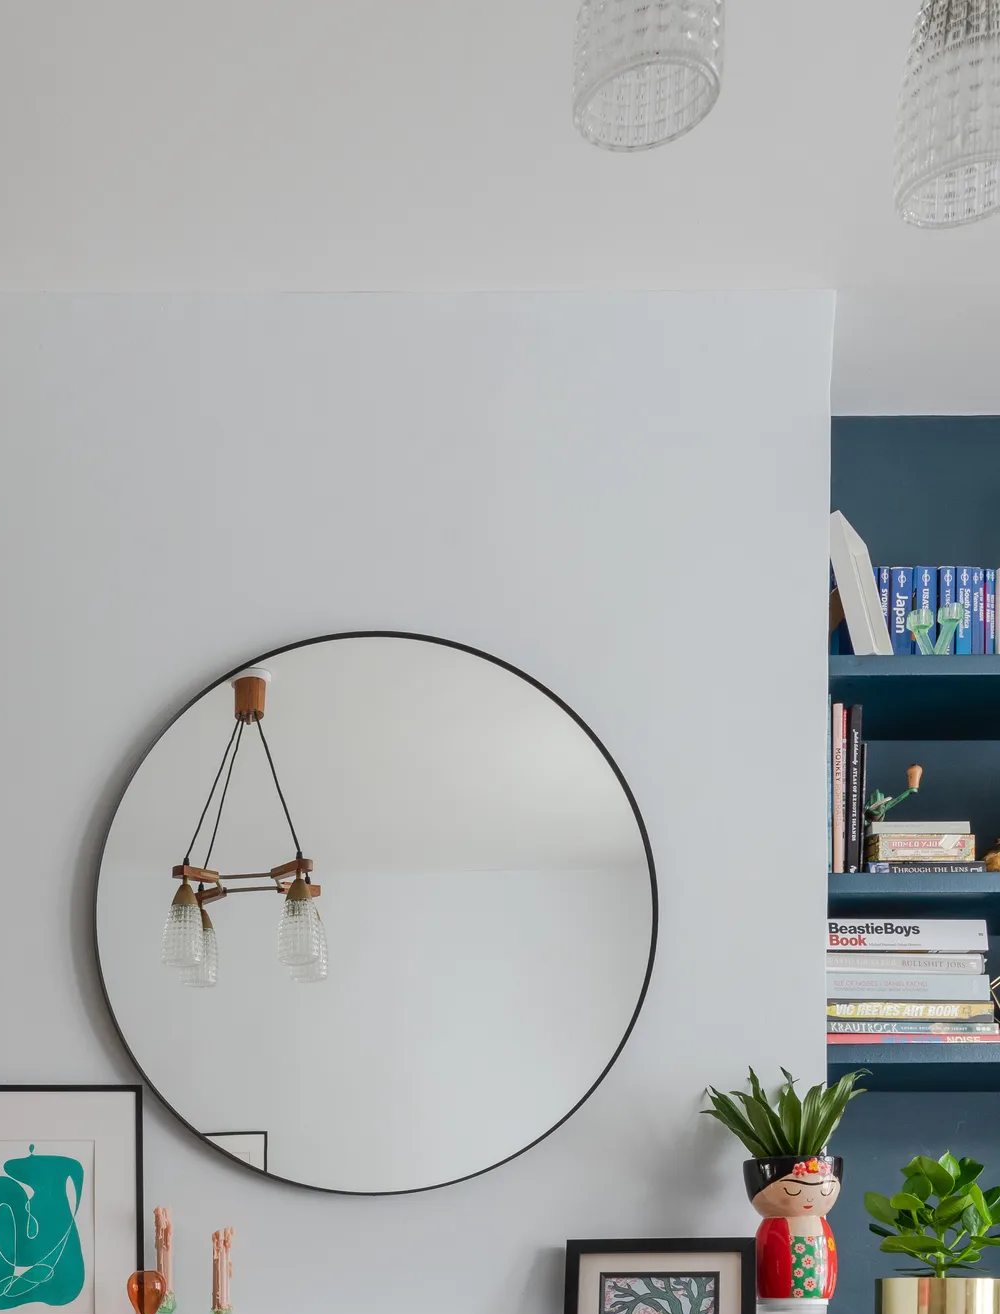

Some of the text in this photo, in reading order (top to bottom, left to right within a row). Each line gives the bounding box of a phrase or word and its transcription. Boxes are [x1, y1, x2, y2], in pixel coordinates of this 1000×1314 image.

[893, 592, 909, 634] Japan
[852, 785, 857, 793] OF
[829, 934, 868, 947] Book
[901, 960, 943, 968] BULLSHIT
[946, 960, 966, 969] JOBS
[835, 1004, 960, 1017] VIC REEVES ART BOOK
[830, 1022, 899, 1033] KRAUTROCK
